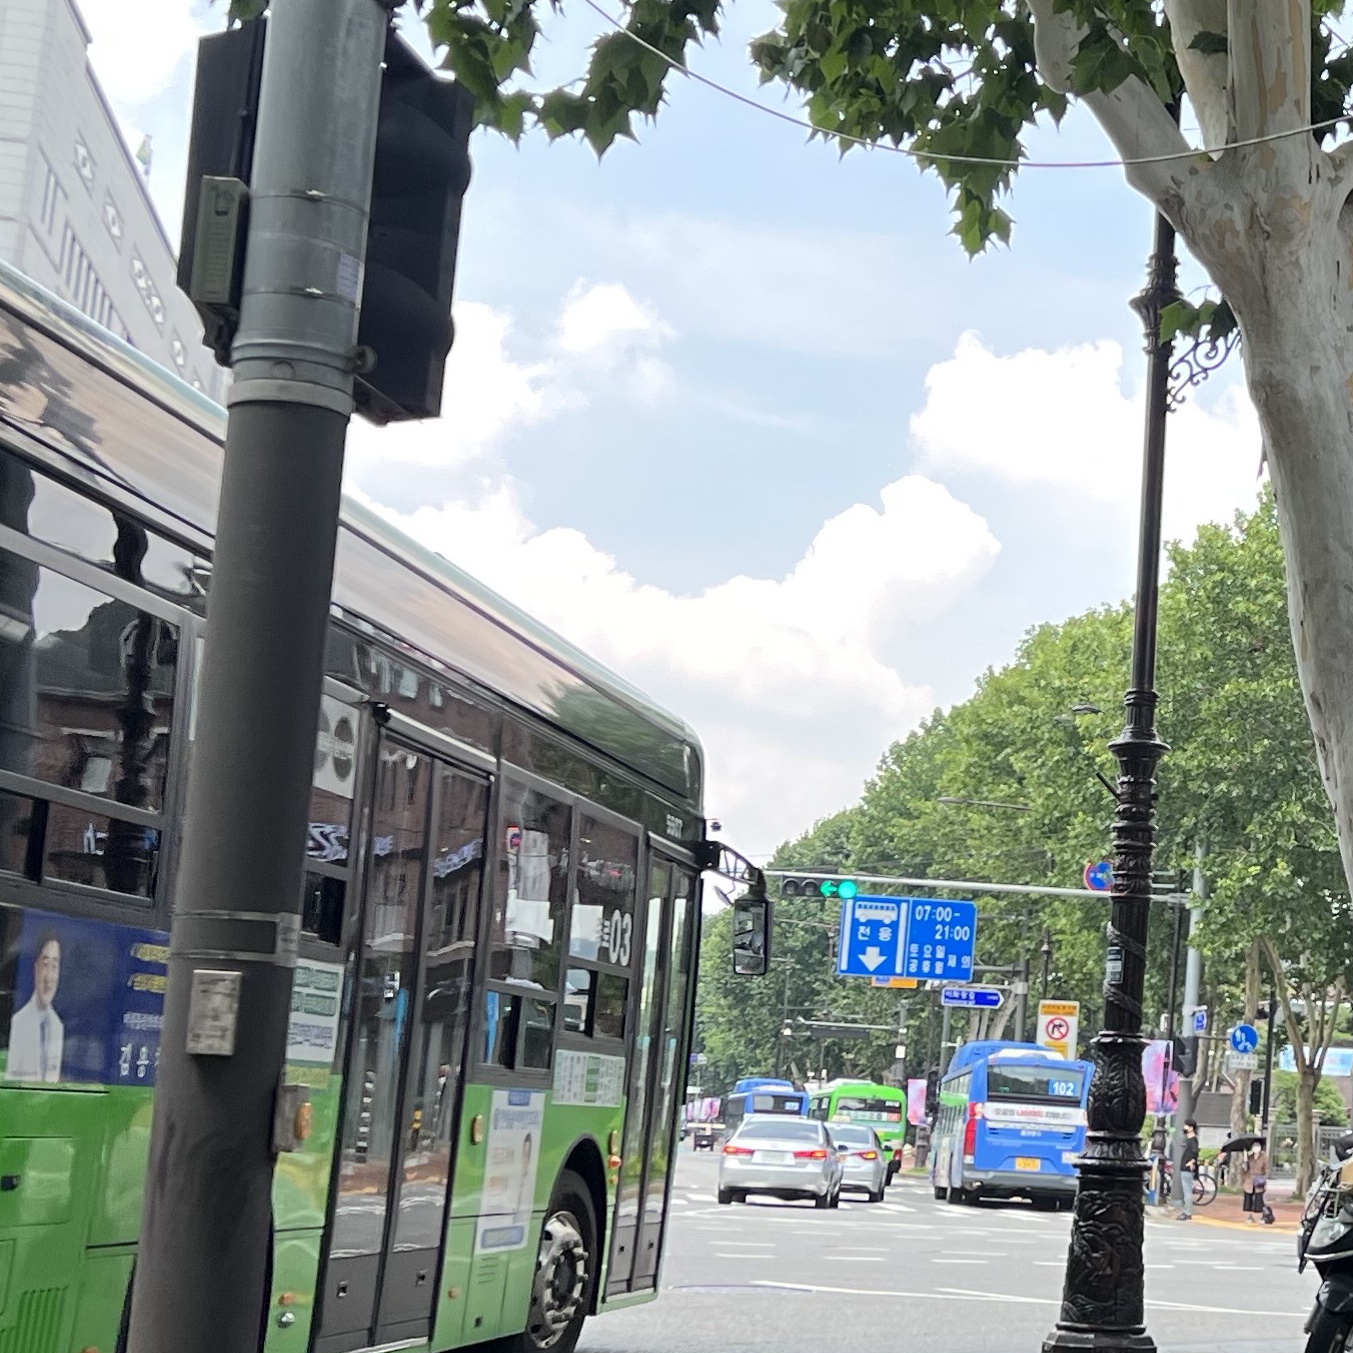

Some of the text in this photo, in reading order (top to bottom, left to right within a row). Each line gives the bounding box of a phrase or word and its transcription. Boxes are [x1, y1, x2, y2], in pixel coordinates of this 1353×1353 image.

[857, 925, 893, 942] 전용
[934, 924, 970, 941] 21:00
[909, 943, 946, 959] 토요일
[1052, 1081, 1075, 1096] 102
